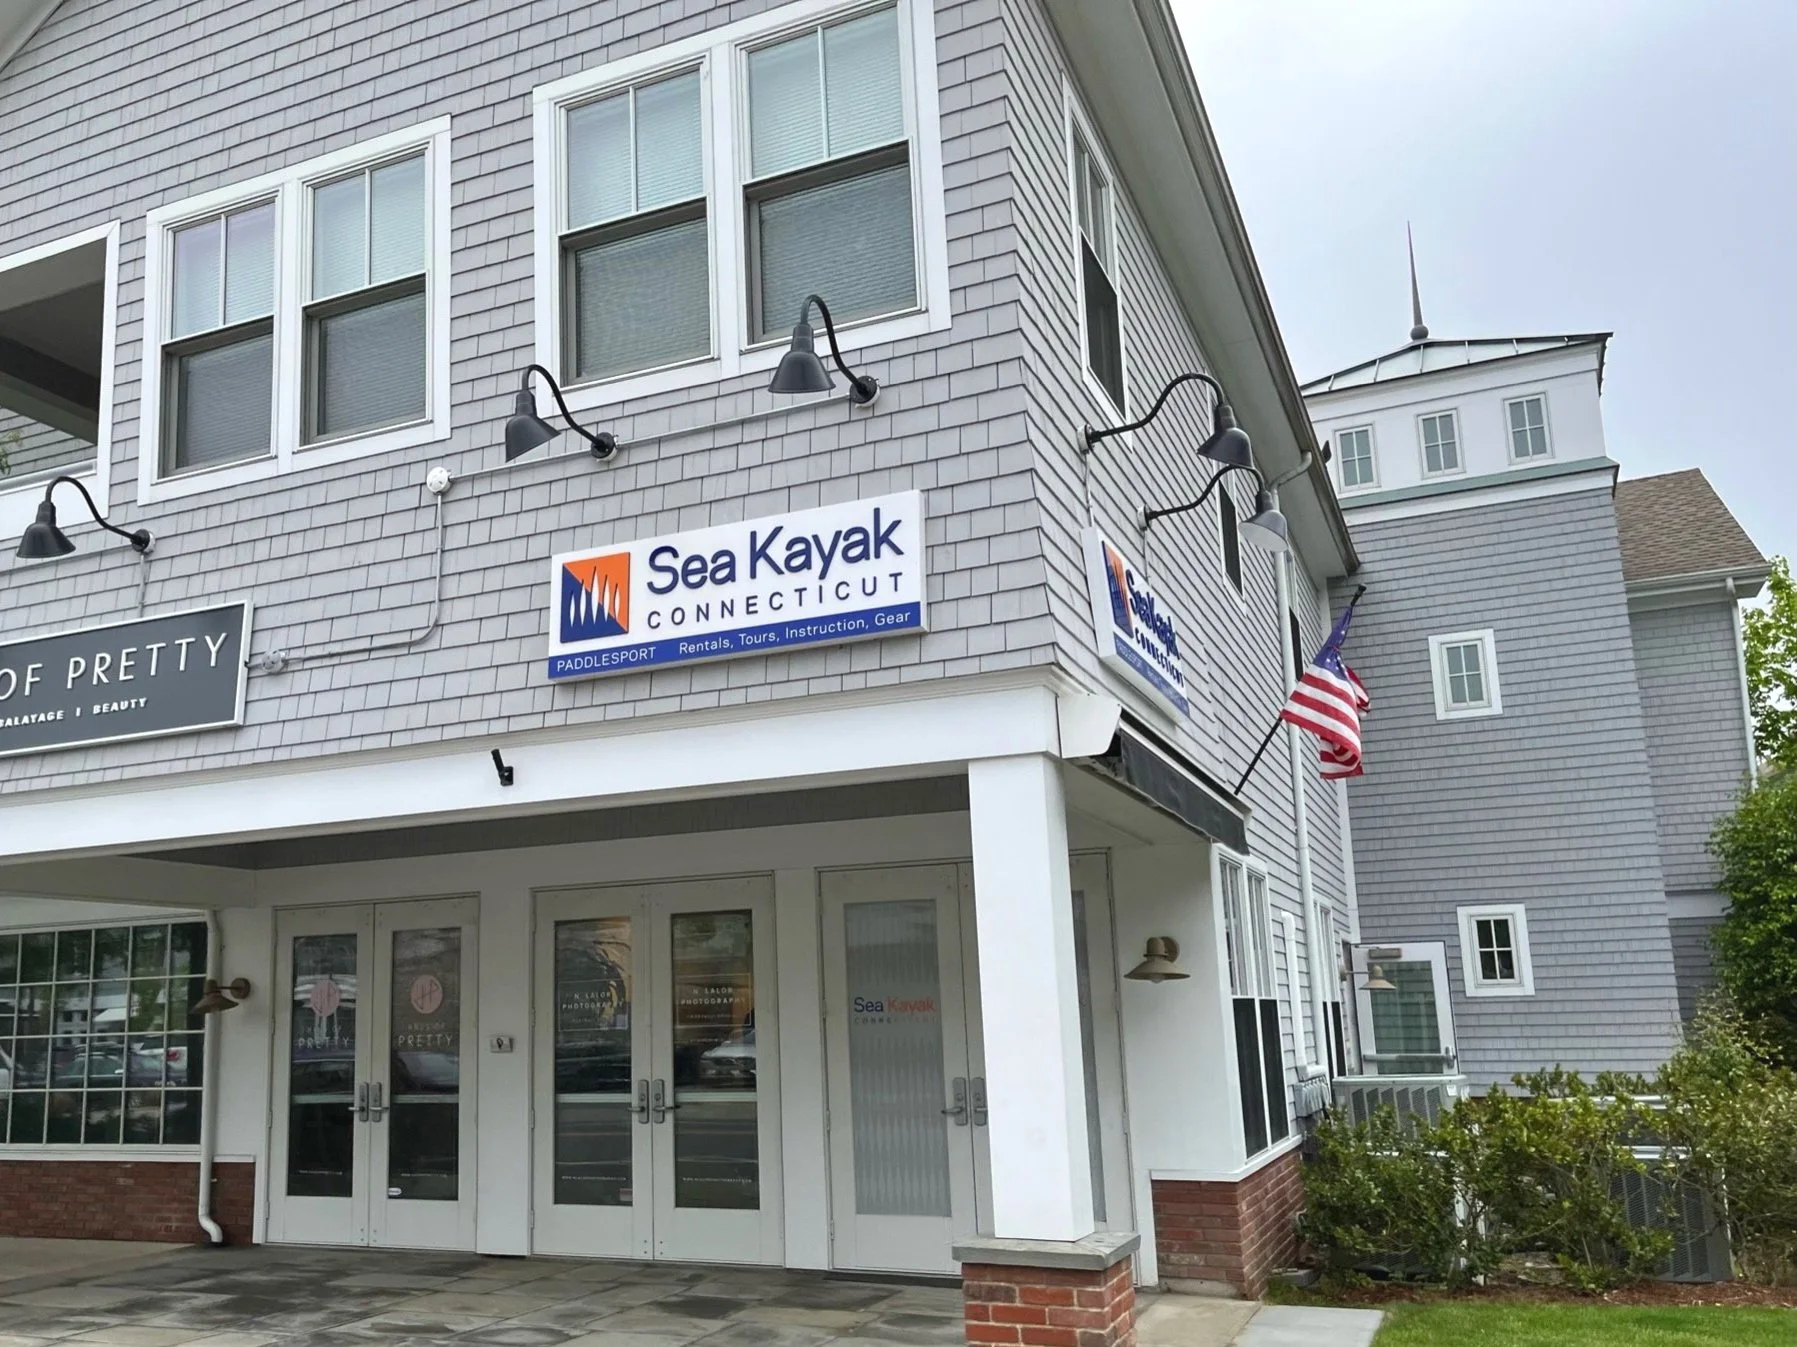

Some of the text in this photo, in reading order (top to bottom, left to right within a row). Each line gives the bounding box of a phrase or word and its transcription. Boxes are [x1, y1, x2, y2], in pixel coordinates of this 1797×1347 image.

[646, 506, 905, 595] Sea Kayak
[646, 572, 904, 630] CONNECTICUT
[0, 632, 227, 700] OF PRETTY
[556, 609, 911, 673] PADDLESPORT Rentals, Tours, Instruction, Gear
[1134, 627, 1185, 688] CONNECTICUT
[93, 697, 148, 715] BEAUTY
[562, 999, 624, 1010] PHOTOGRAPY
[854, 996, 937, 1015] Sea Kayak
[398, 1034, 454, 1048] PRETTY
